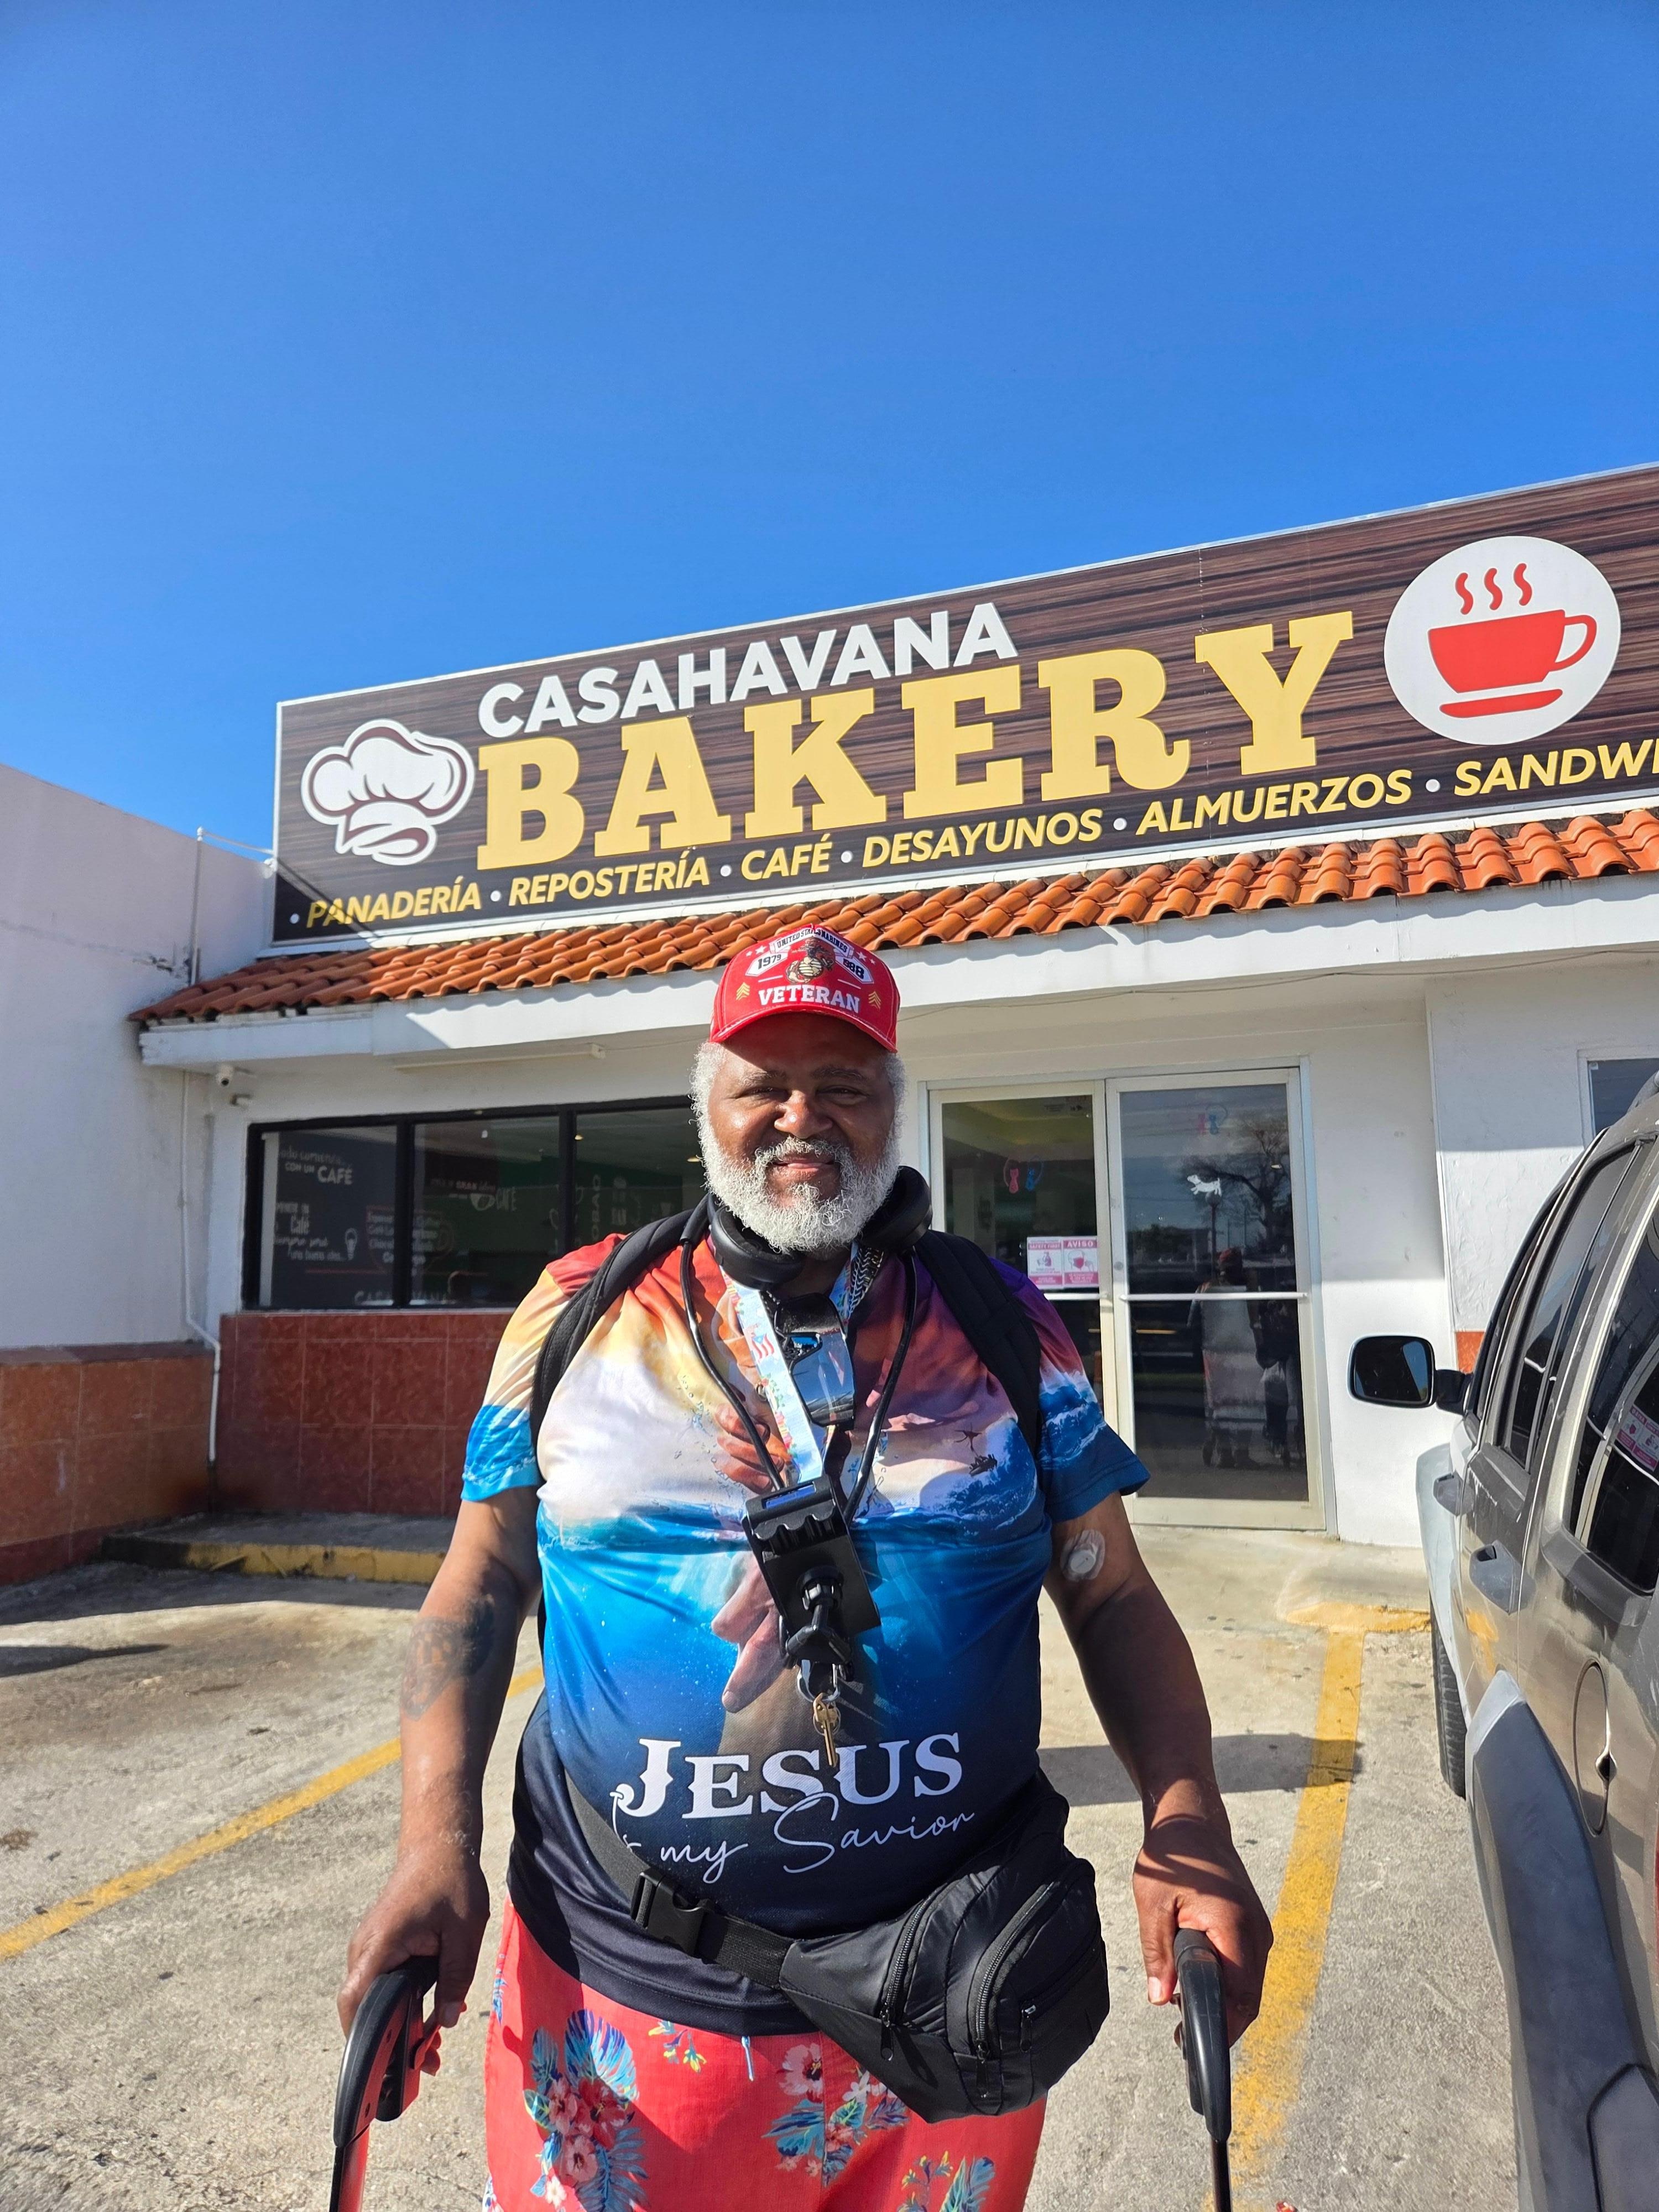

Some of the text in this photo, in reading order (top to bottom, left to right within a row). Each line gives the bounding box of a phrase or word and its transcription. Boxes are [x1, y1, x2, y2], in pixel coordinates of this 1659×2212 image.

[478, 602, 1019, 738] CASAHAVANA
[477, 611, 1354, 870] BAKERY
[306, 876, 481, 928] PANADERÍA
[508, 851, 709, 906] REPOSTERÍA
[741, 833, 833, 880] CAFÉ
[862, 808, 1103, 868] DESAYUNOS
[1136, 769, 1412, 835] ALMUERZOS
[758, 953, 782, 969] 1979
[776, 932, 801, 948] UNITED
[821, 930, 848, 953] MARINES
[758, 984, 860, 1014] VETERAN
[615, 1732, 963, 1819] JESUS
[660, 1840, 748, 1884] my
[773, 1791, 975, 1874] Savior
